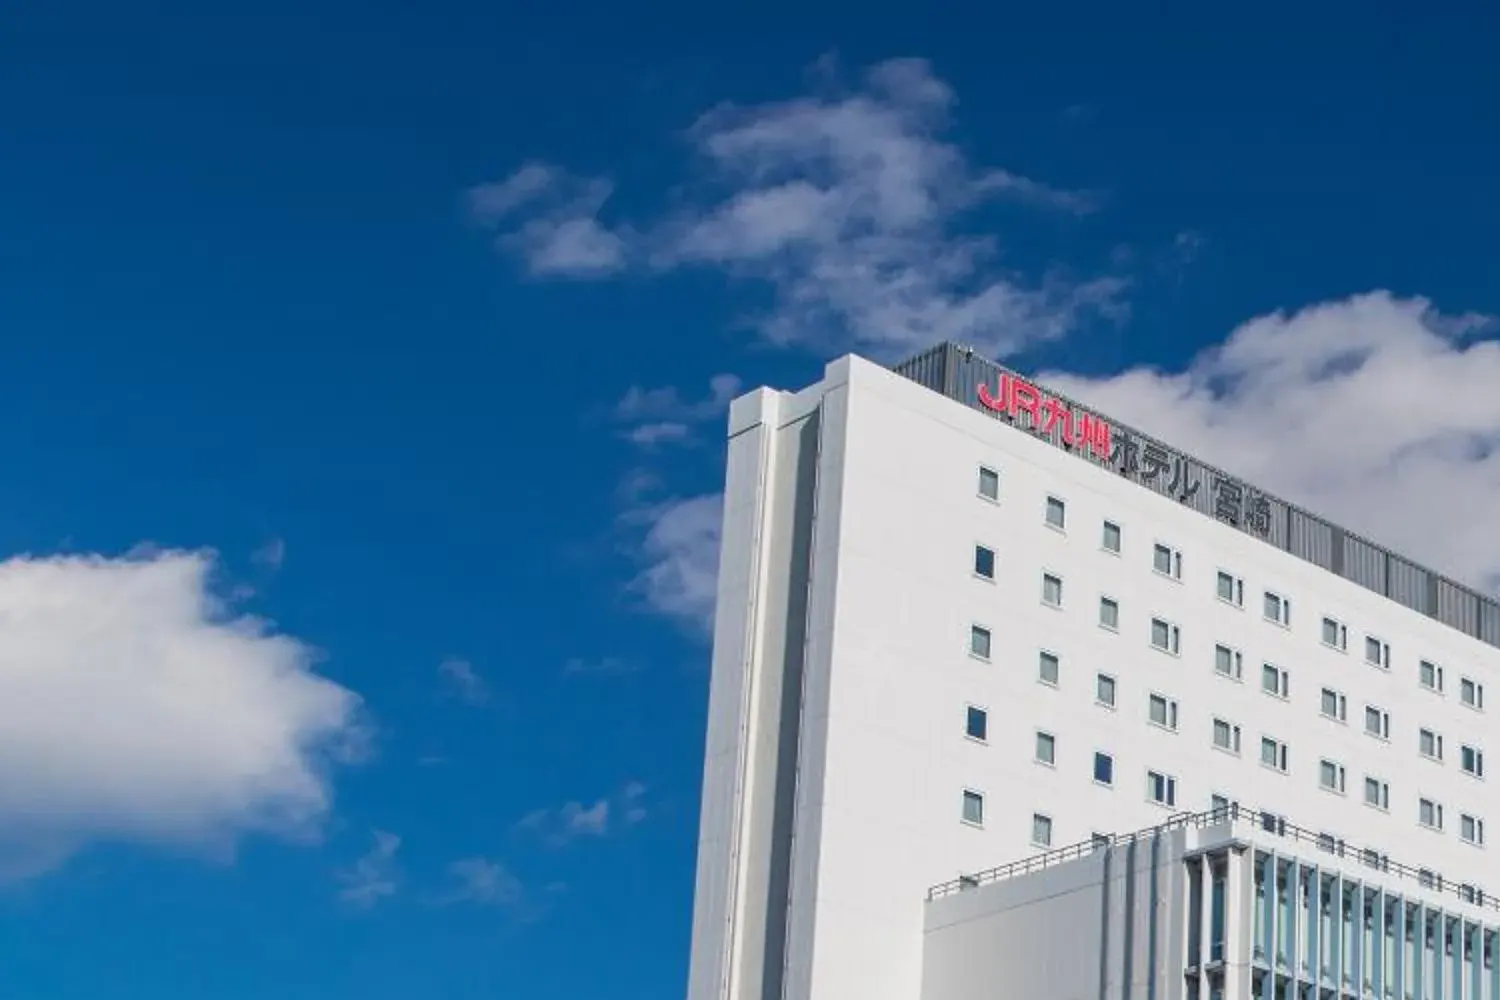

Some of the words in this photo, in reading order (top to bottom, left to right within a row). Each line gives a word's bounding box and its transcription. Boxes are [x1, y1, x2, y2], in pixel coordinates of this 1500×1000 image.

[977, 372, 1200, 496] JR九州ホテル
